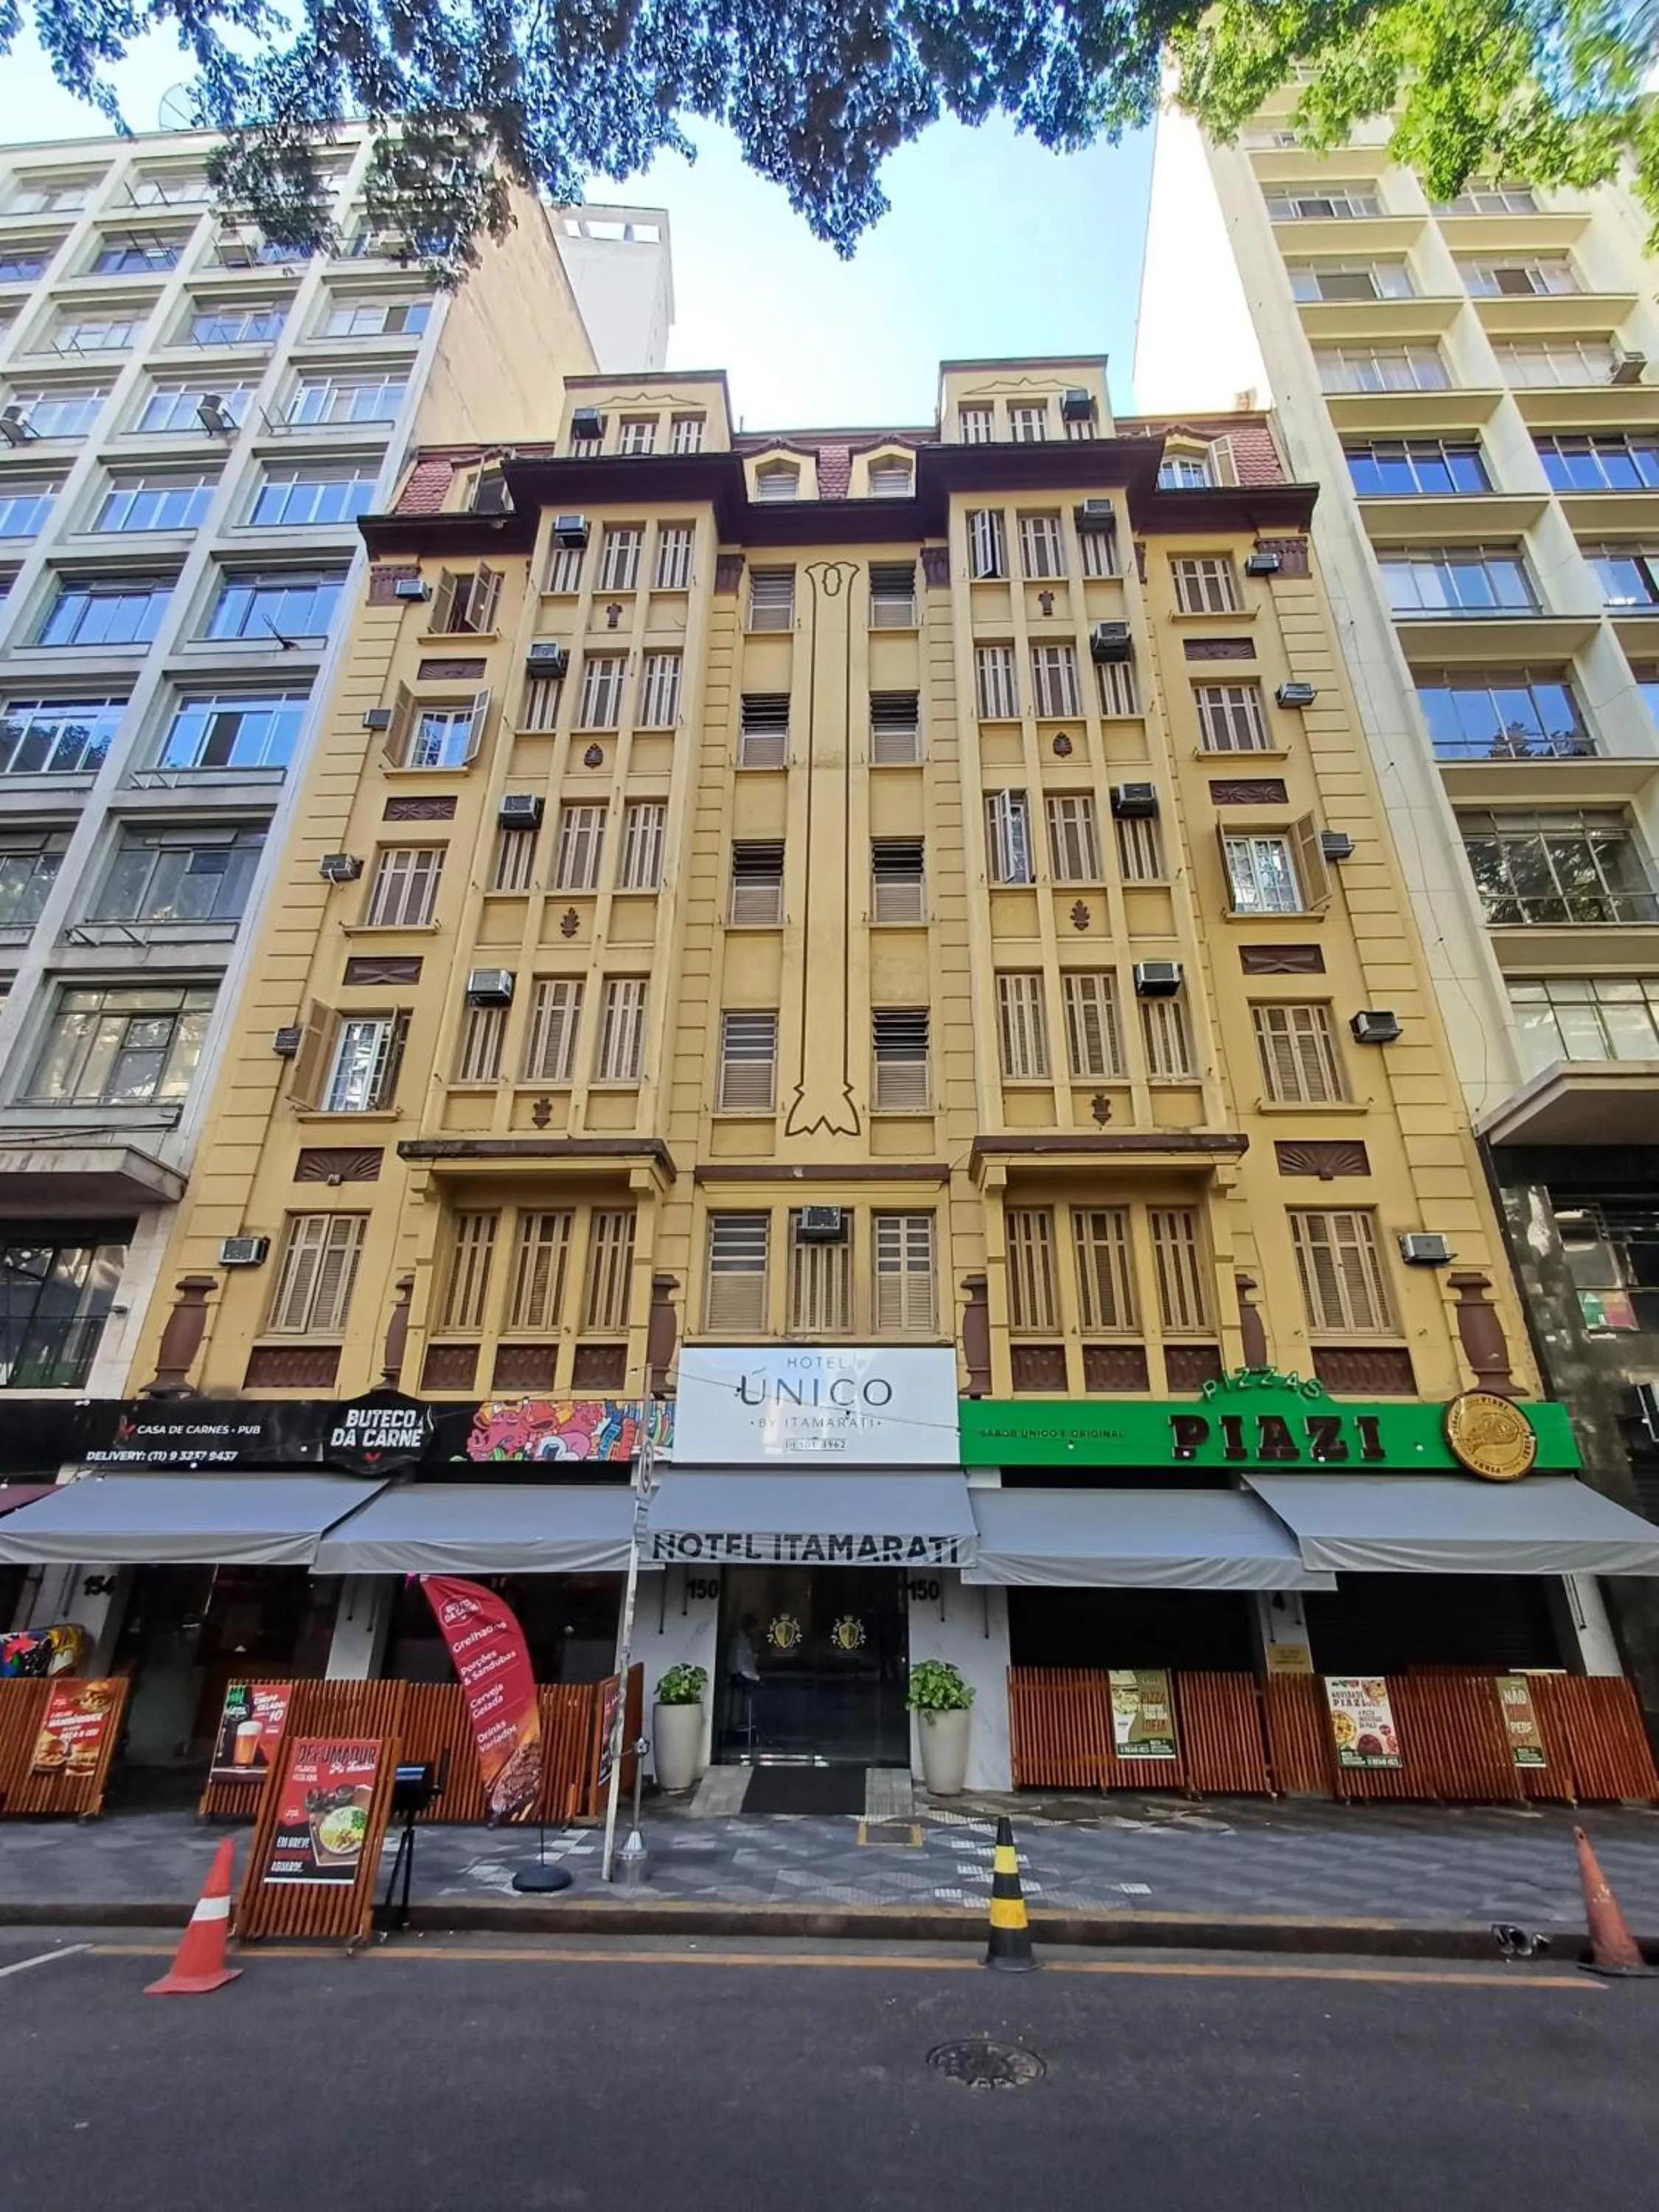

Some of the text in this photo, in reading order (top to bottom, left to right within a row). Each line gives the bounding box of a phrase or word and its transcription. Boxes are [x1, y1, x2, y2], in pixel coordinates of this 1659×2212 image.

[787, 1356, 846, 1369] HOTEL
[740, 1366, 892, 1406] ÚNICO
[1203, 1367, 1324, 1402] PIZZAS
[136, 1425, 261, 1434] CASA DE CARNES PUB
[346, 1409, 417, 1427] BUTECO
[785, 1417, 874, 1429] ITAMARATI
[330, 1427, 422, 1447] DA CARNE
[821, 1439, 846, 1449] 1962
[980, 1429, 1016, 1438] SABOR
[1071, 1429, 1124, 1439] ORIGINAL
[1168, 1414, 1385, 1460] PIAZI
[86, 1451, 147, 1461] DELIVERY:
[147, 1451, 167, 1461] (11)
[169, 1451, 178, 1461] 9
[653, 1533, 960, 1564] HOTEL ITAMARATI
[688, 1579, 719, 1599] 150
[910, 1579, 939, 1601] 150
[461, 1649, 497, 1676] Porções
[472, 1650, 517, 1682] Sandubas
[470, 1683, 504, 1709] Cerveja
[472, 1695, 504, 1719] Gelada
[477, 1719, 507, 1743] Drinks
[479, 1725, 518, 1753] Variados
